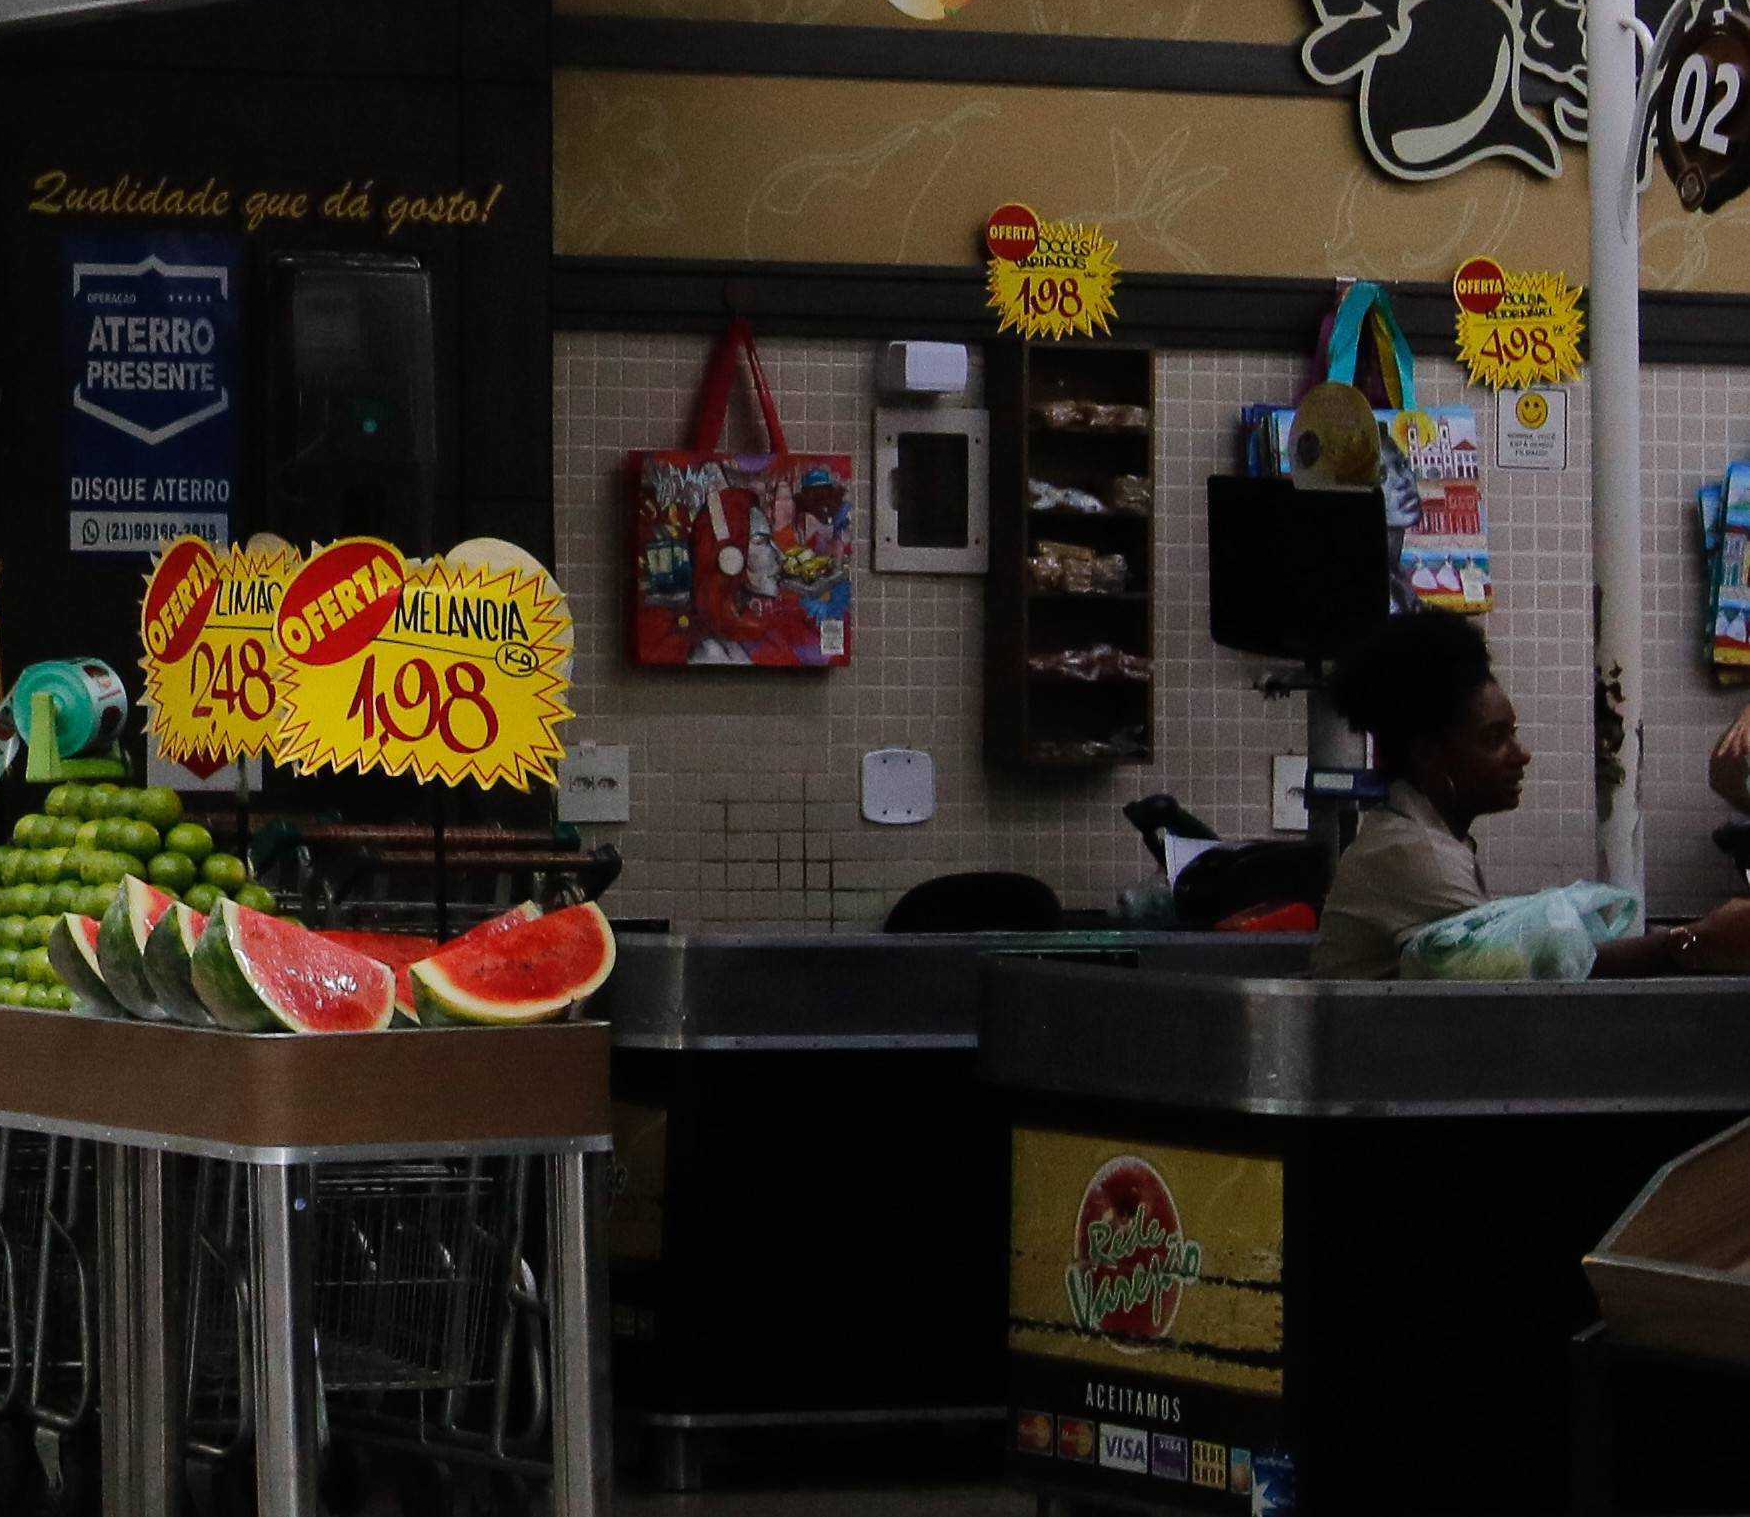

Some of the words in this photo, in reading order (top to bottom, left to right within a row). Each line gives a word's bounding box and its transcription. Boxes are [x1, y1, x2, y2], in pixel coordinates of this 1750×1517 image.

[1671, 52, 1741, 155] 02
[28, 170, 232, 217] Qualidade
[244, 188, 308, 231] que
[323, 177, 375, 219] dá
[386, 182, 504, 234] gosto!
[989, 225, 1036, 240] OFERTA
[1457, 279, 1503, 295] OFERTA
[88, 316, 215, 355] ATERRO
[87, 361, 215, 391] PRESENTE
[71, 477, 147, 504] DISQUE
[153, 478, 230, 502] ATERRO
[146, 552, 219, 654] OFERTA
[280, 554, 399, 655] OFERTA
[394, 590, 530, 642] MELANCIA
[346, 653, 499, 755] 1,98
[1088, 1203, 1166, 1271] Rede
[1066, 1234, 1202, 1332] Varejão
[1085, 1382, 1181, 1423] ACEITAMOS
[1105, 1435, 1146, 1462] VISA
